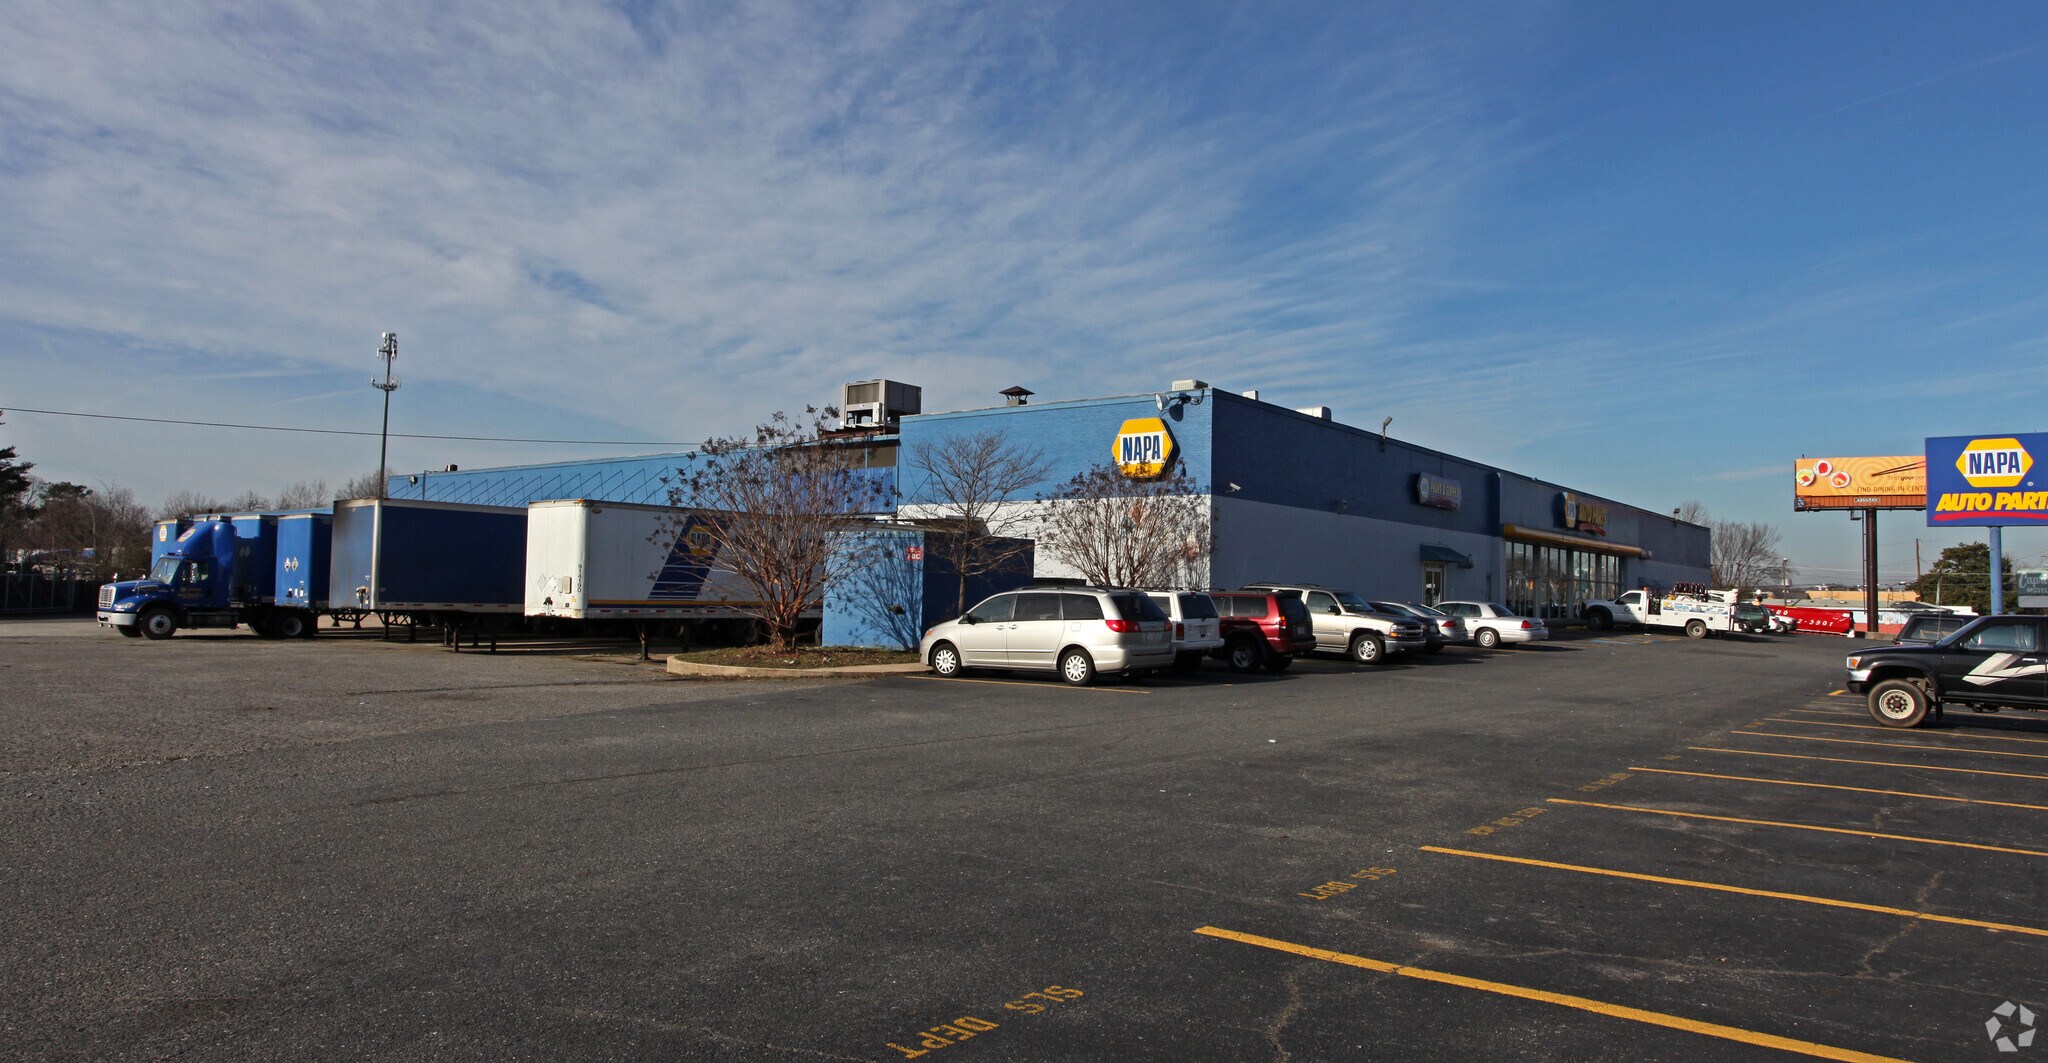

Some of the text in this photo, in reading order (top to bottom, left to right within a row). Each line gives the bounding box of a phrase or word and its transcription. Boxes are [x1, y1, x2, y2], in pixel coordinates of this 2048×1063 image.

[1122, 435, 1162, 461] NAPA
[1968, 451, 2020, 474] NAPA
[1935, 491, 2048, 512] AUTO PART
[885, 985, 1084, 1060] SLS DEPT
